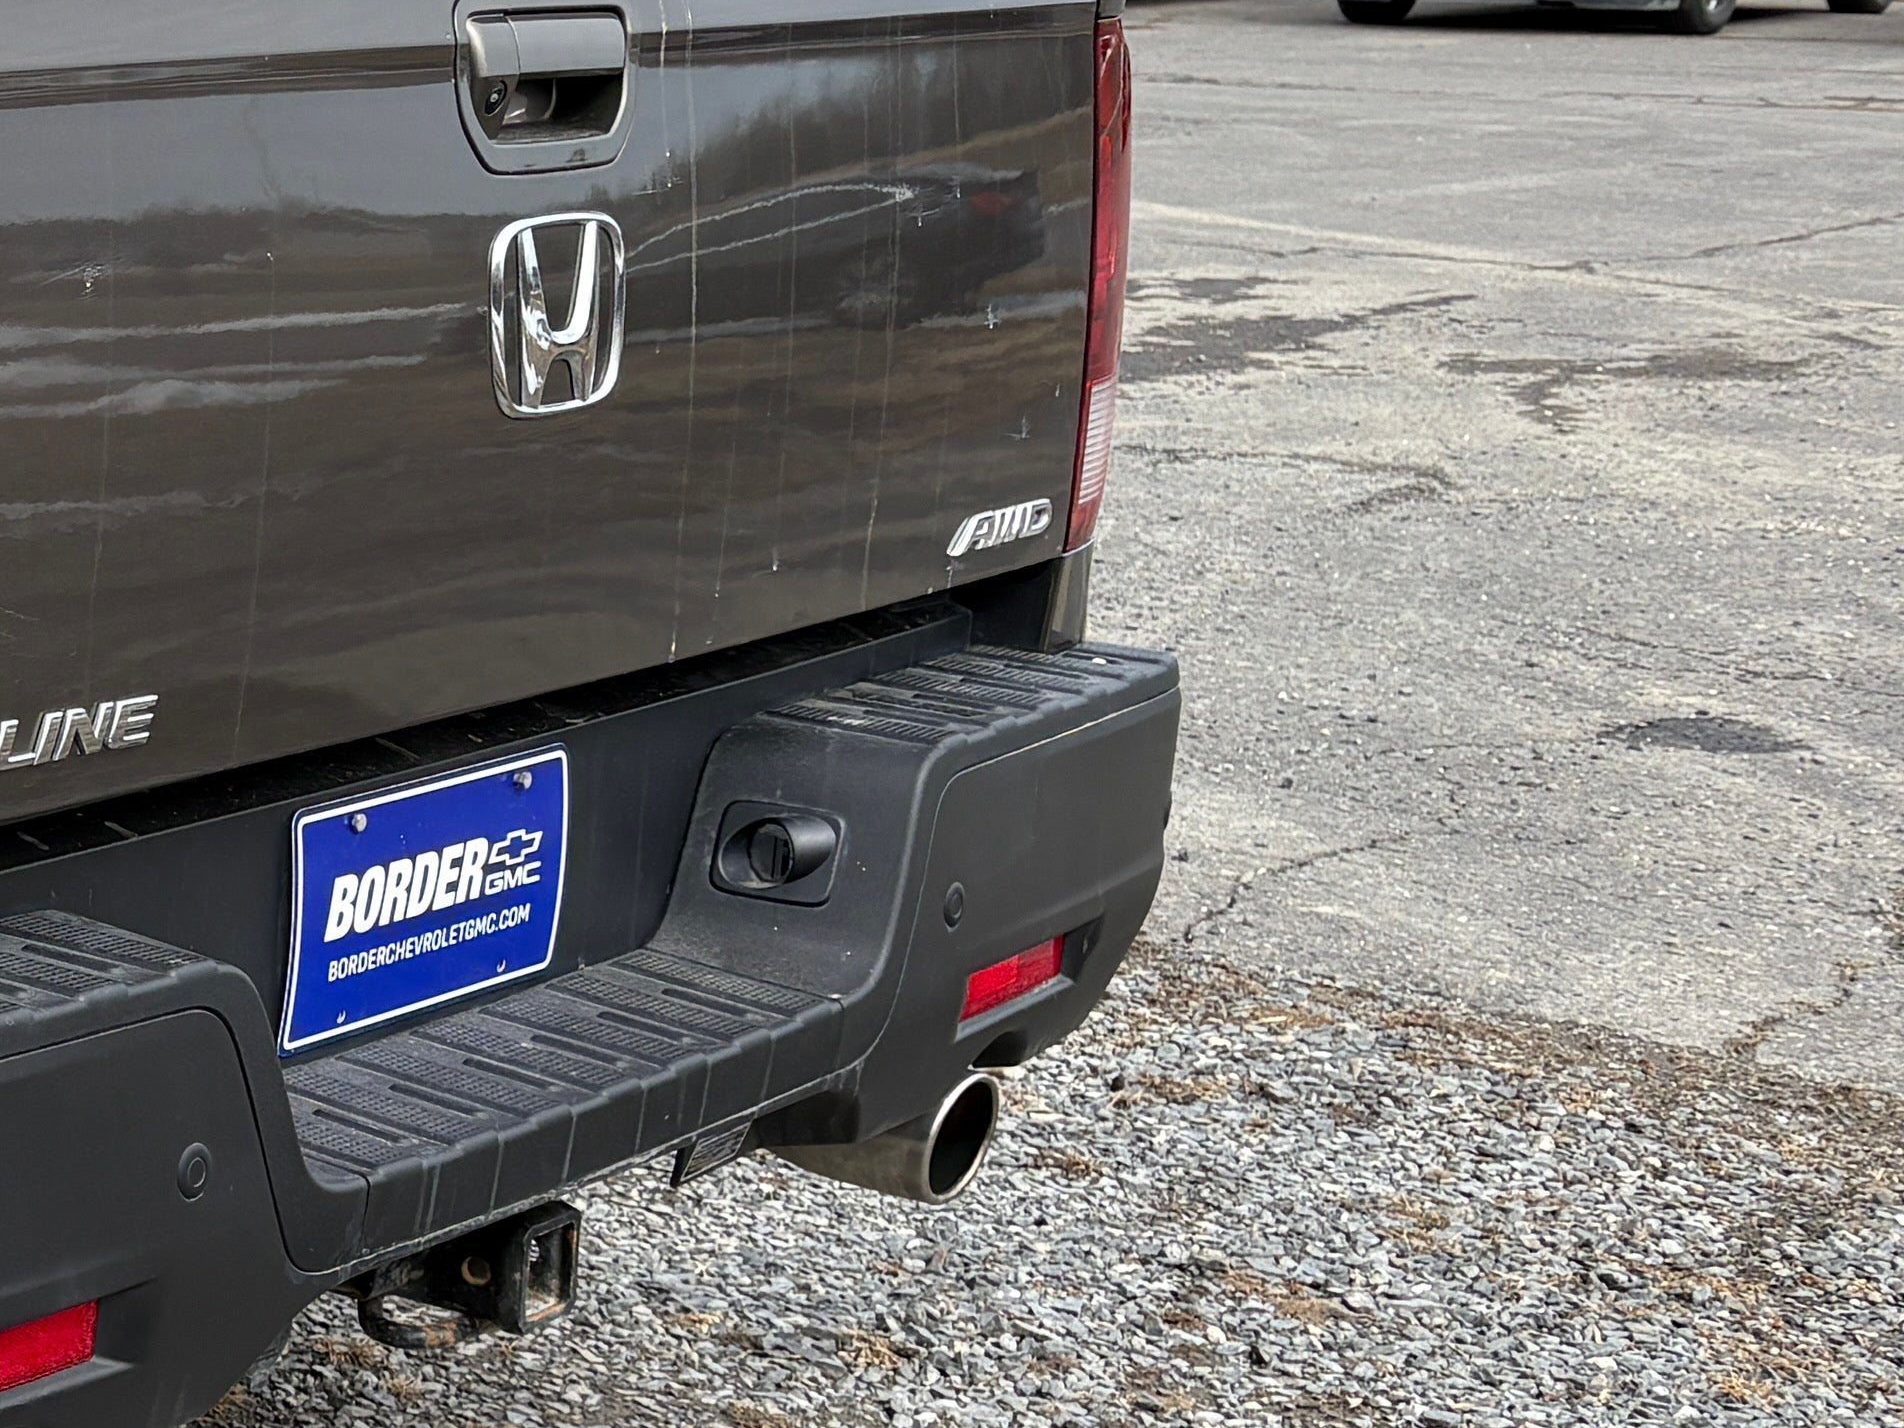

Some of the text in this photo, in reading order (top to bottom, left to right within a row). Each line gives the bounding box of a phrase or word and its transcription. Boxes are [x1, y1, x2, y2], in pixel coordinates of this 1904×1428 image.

[947, 498, 1054, 557] AWD
[323, 837, 542, 944] BORDER GMC
[327, 903, 532, 983] BORDERCHEVROLETGMC.COM
